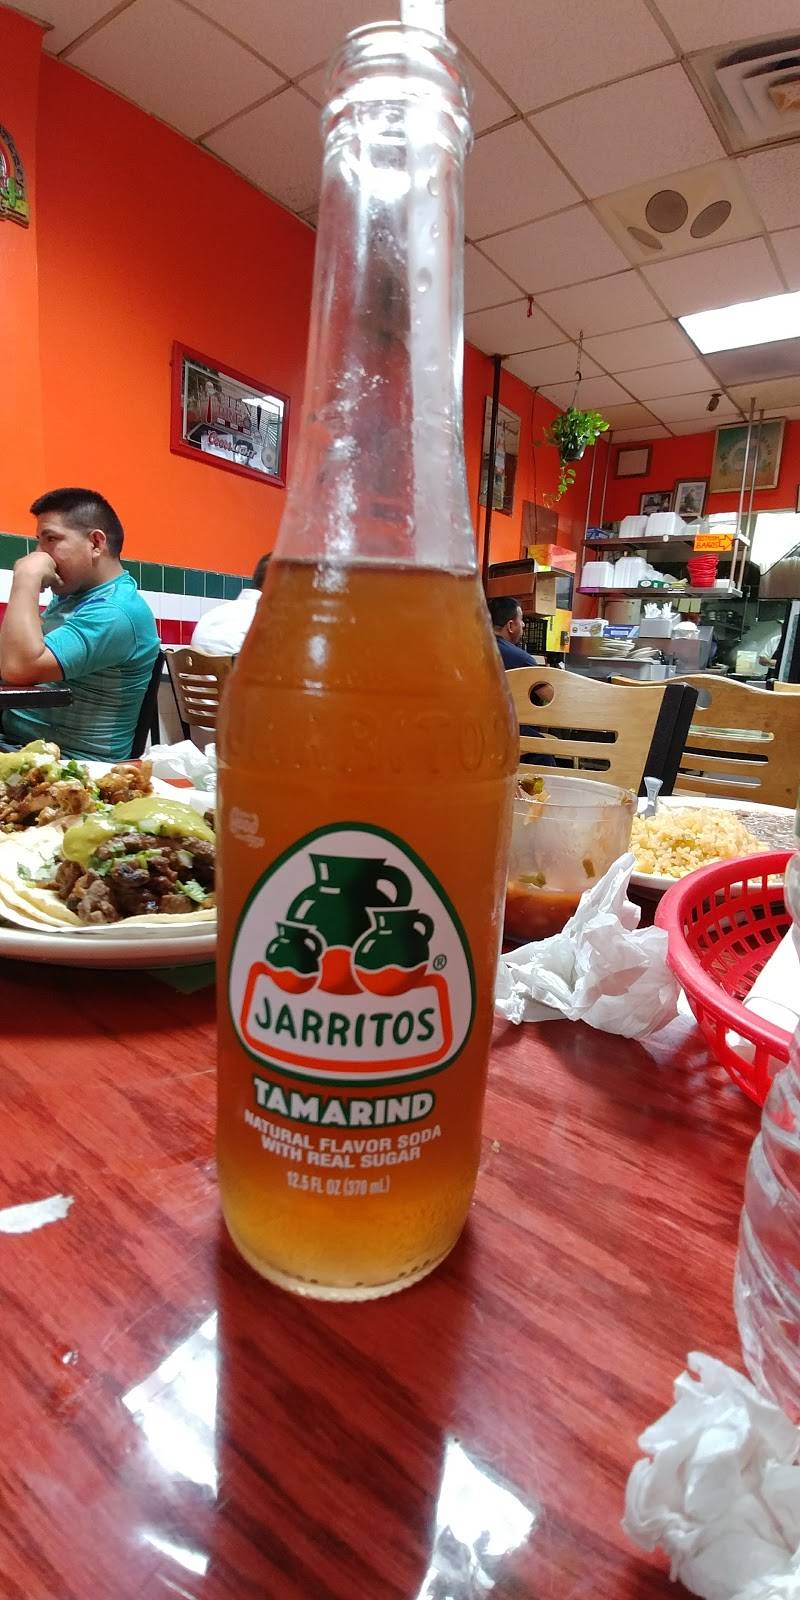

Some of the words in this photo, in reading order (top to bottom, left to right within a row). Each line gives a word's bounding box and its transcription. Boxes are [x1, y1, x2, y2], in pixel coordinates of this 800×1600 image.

[255, 997, 435, 1047] JARRITOS
[254, 1077, 434, 1126] TAMARIND
[244, 1109, 313, 1149] NATURAL
[319, 1137, 391, 1155] FLAVOR
[397, 1124, 441, 1148] SODA
[261, 1134, 302, 1162] WITH
[307, 1151, 355, 1169] REAL
[360, 1146, 421, 1168] SUGAR
[286, 1170, 309, 1191] 12.5
[311, 1176, 323, 1194] FL
[326, 1178, 342, 1196] OZ
